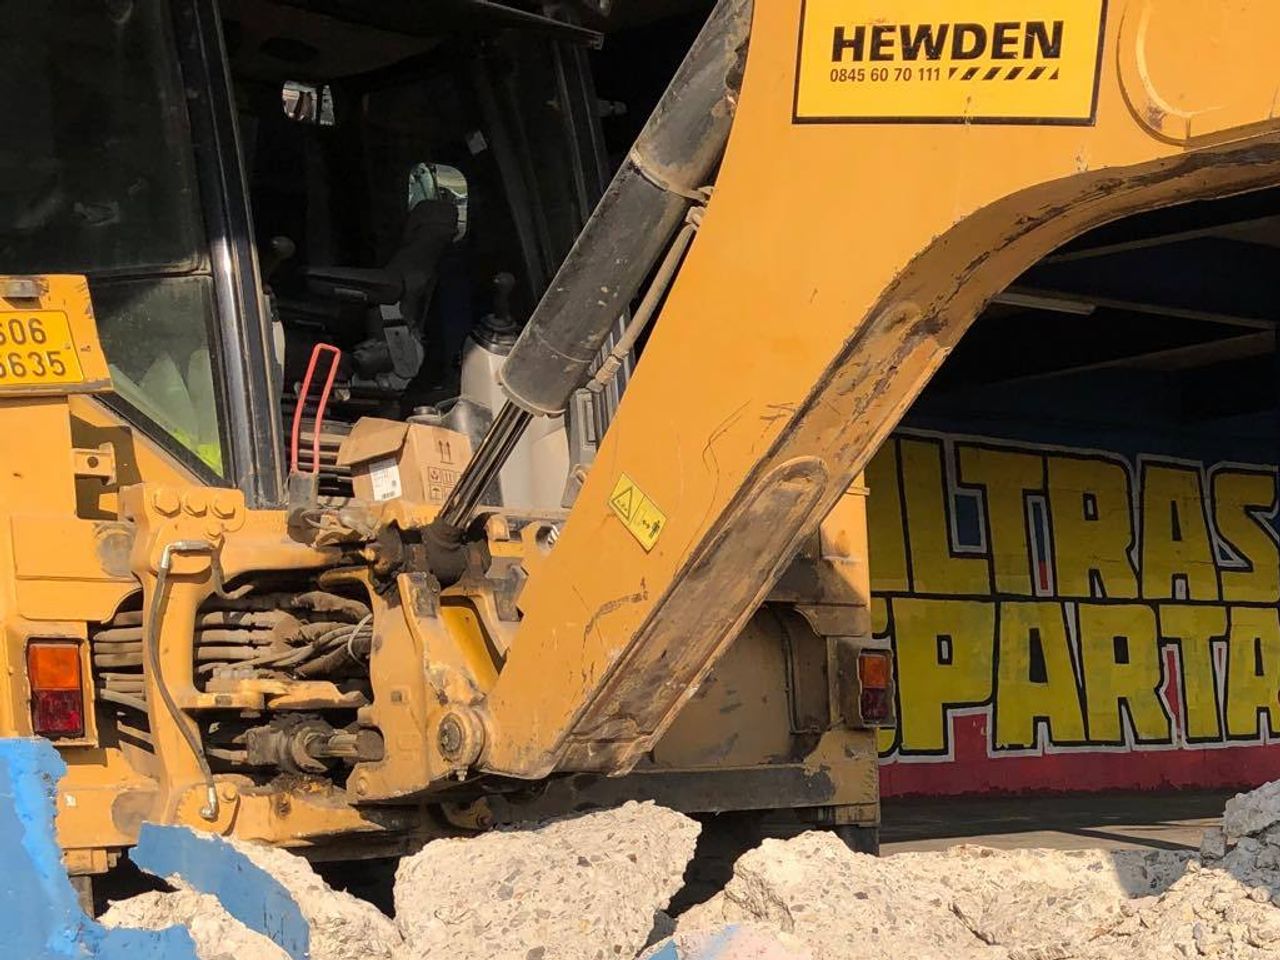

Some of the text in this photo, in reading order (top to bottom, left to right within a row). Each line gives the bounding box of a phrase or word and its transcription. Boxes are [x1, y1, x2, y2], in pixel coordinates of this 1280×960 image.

[831, 20, 1064, 62] HEWDEN
[830, 67, 940, 82] 0845 60 70 111
